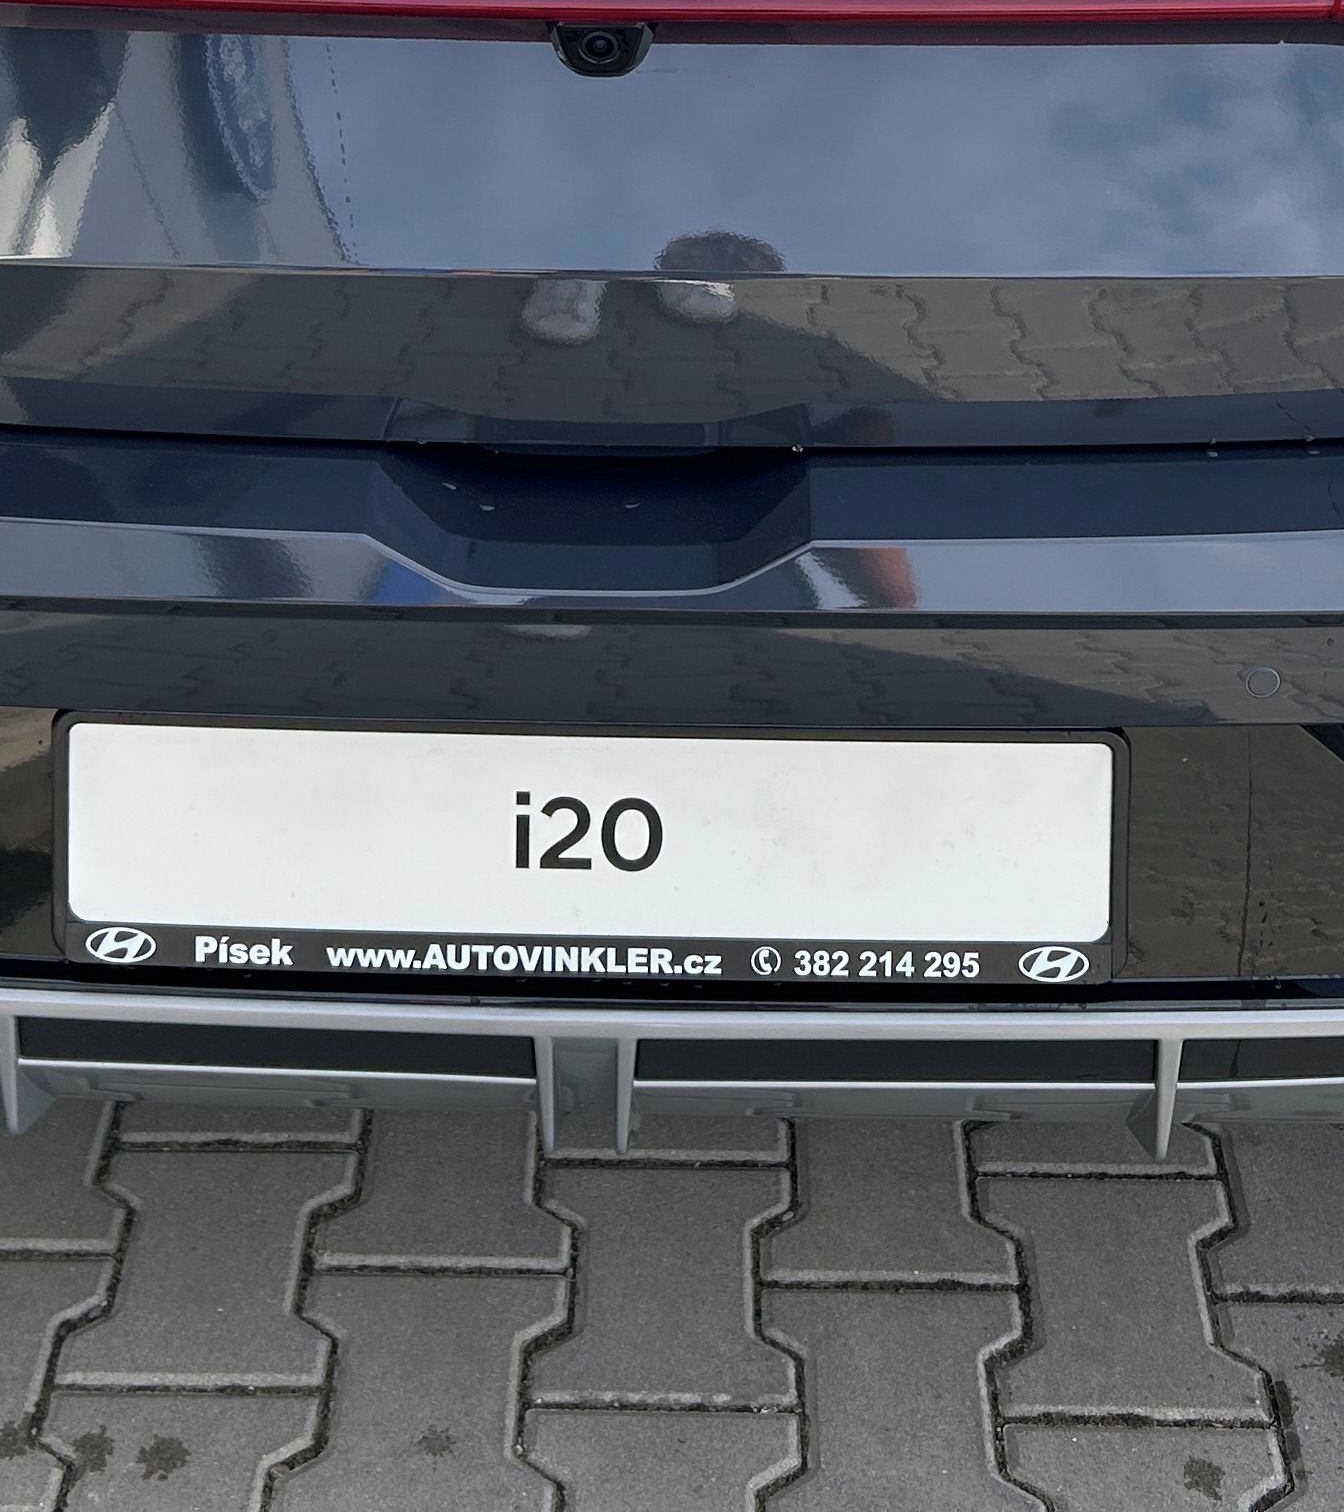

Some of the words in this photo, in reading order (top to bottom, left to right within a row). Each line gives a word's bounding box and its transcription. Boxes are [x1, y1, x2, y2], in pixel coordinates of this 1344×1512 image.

[515, 791, 663, 872] i20
[195, 935, 294, 966] Písek
[326, 944, 722, 976] www.AUTOVINKLER.cz
[793, 950, 849, 977] 382
[858, 950, 915, 977] 214
[923, 951, 980, 978] 295
